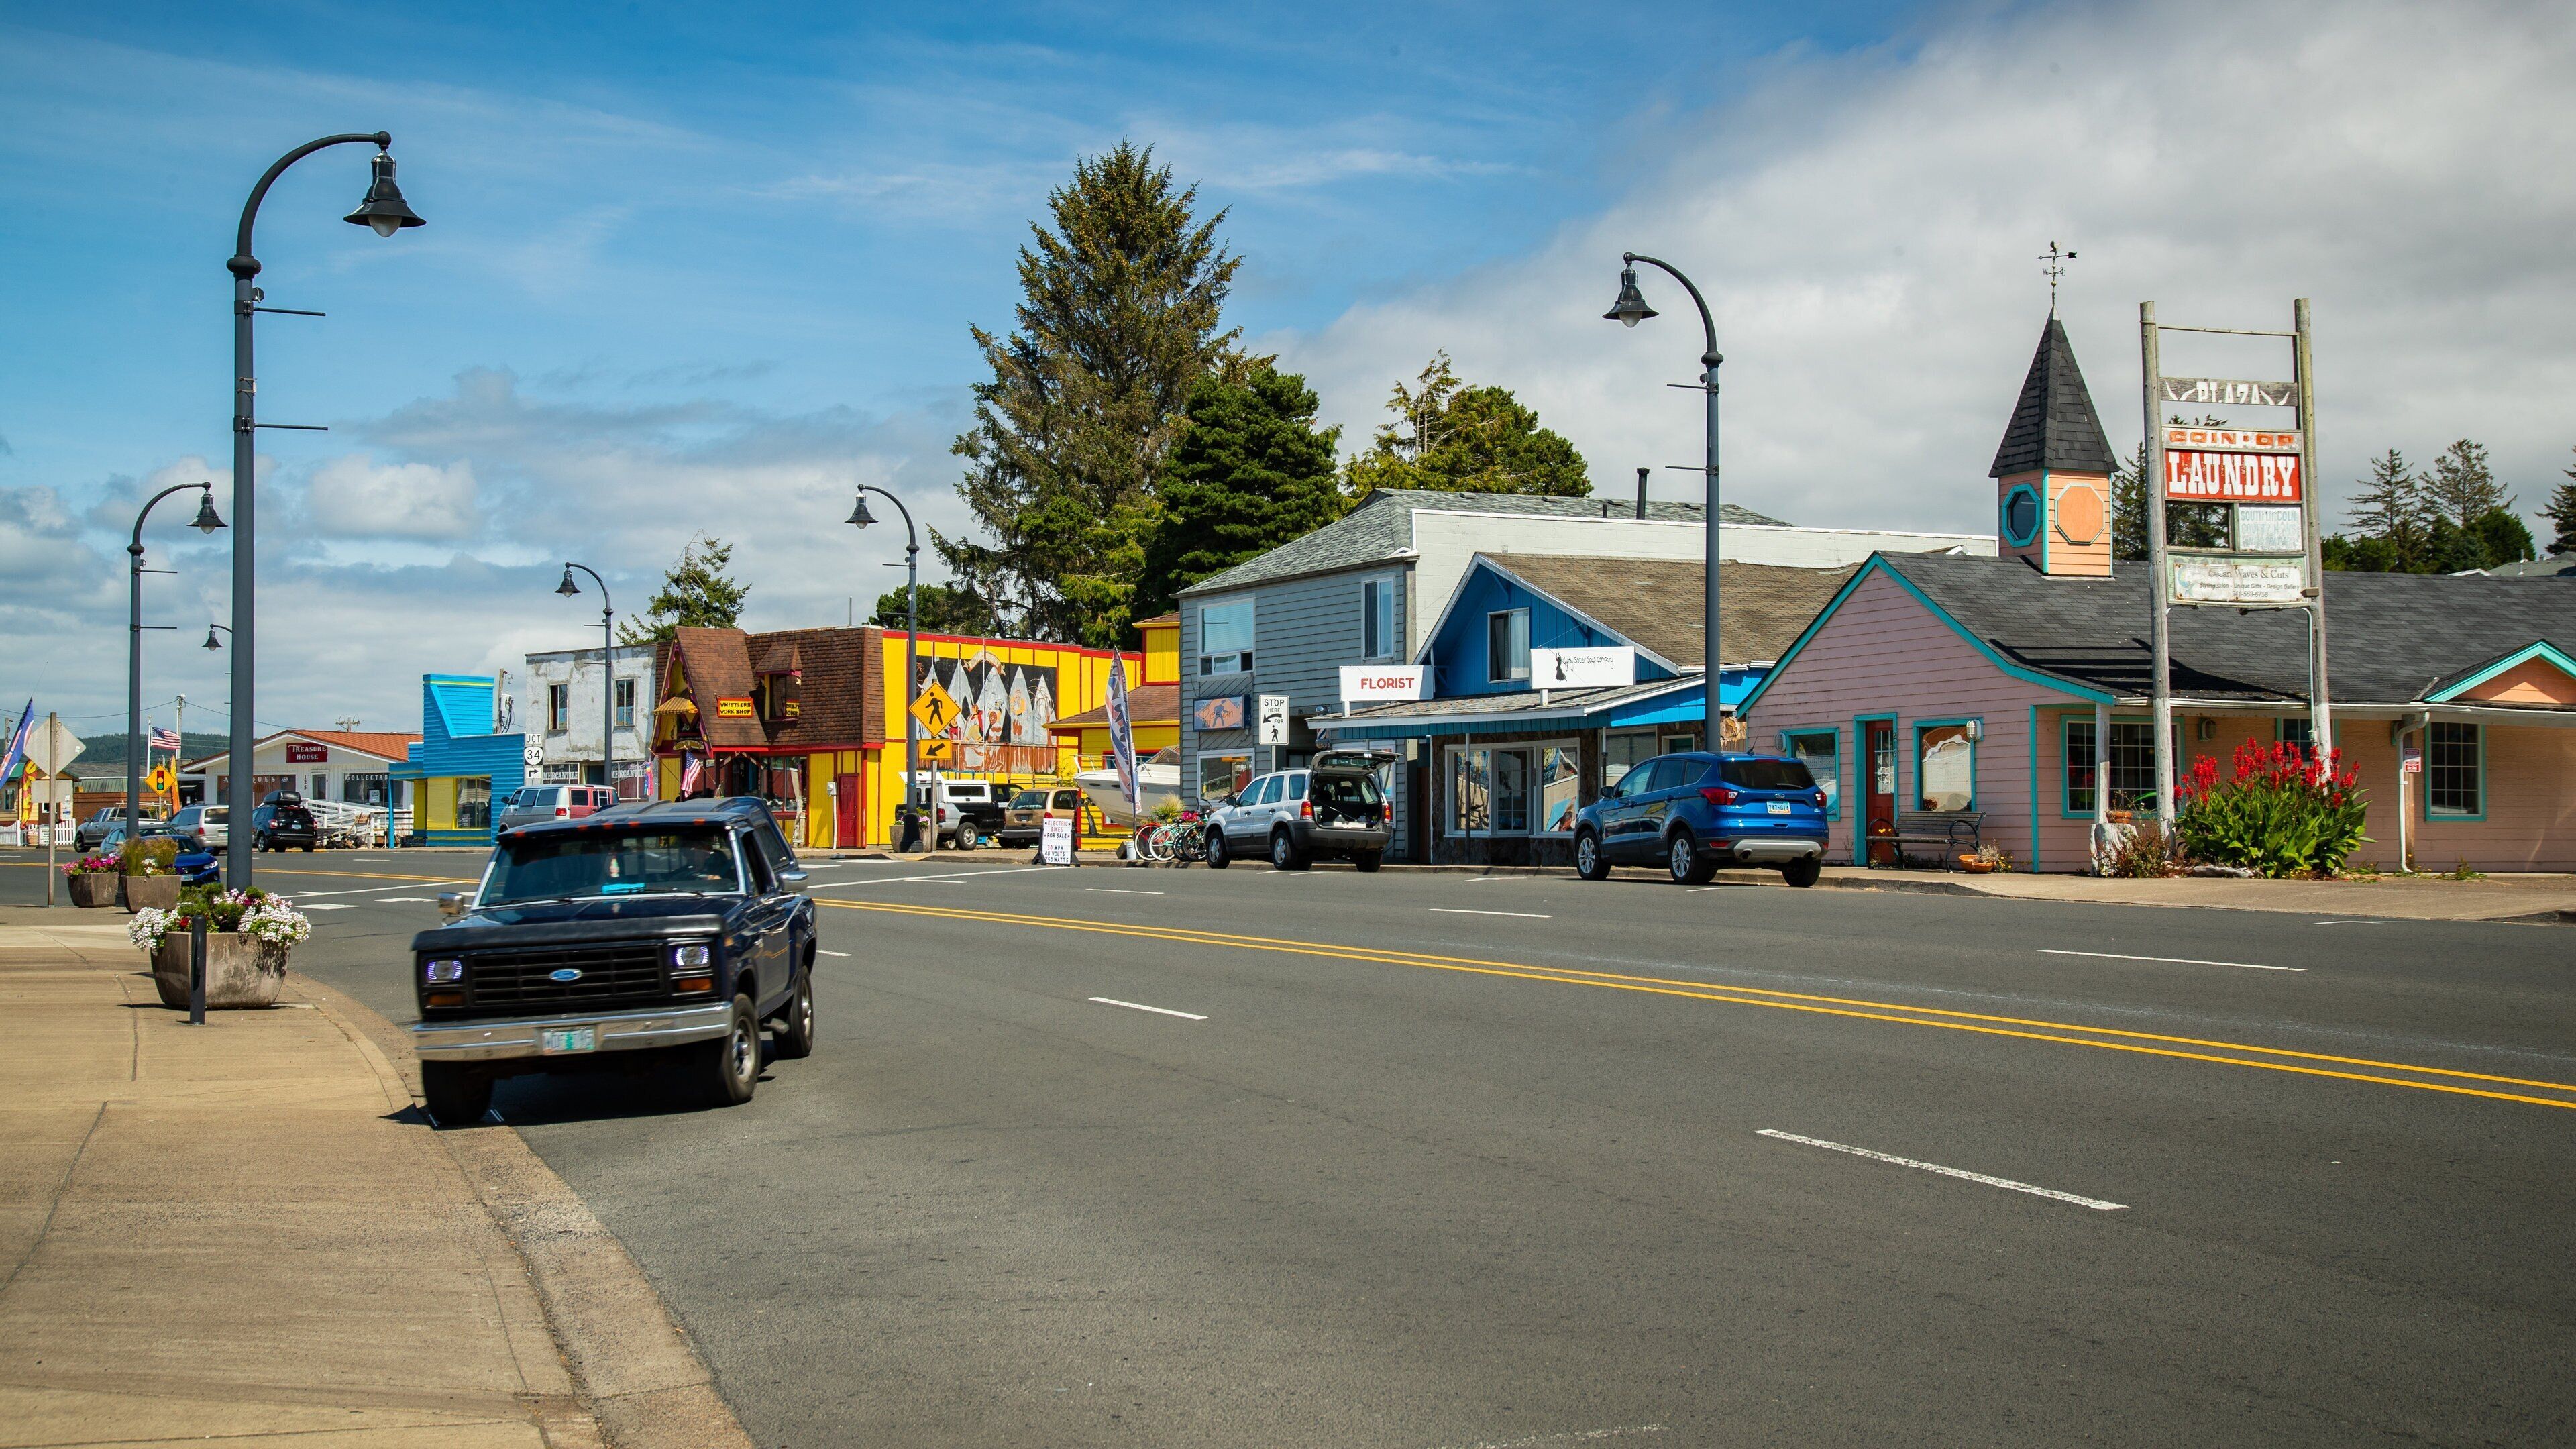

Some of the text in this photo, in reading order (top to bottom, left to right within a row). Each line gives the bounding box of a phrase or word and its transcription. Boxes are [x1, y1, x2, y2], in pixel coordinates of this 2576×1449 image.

[2196, 381, 2260, 404] PLAZA
[2168, 452, 2295, 496] LAUNDRY
[2235, 569, 2258, 578] Waves
[2260, 569, 2268, 578] &
[2270, 569, 2289, 578] Cuts
[1361, 678, 1415, 689] FLORIST
[527, 735, 541, 743] JCT
[288, 744, 326, 753] TREASURE
[527, 749, 540, 759] 34
[543, 771, 578, 780] MERCANTILE
